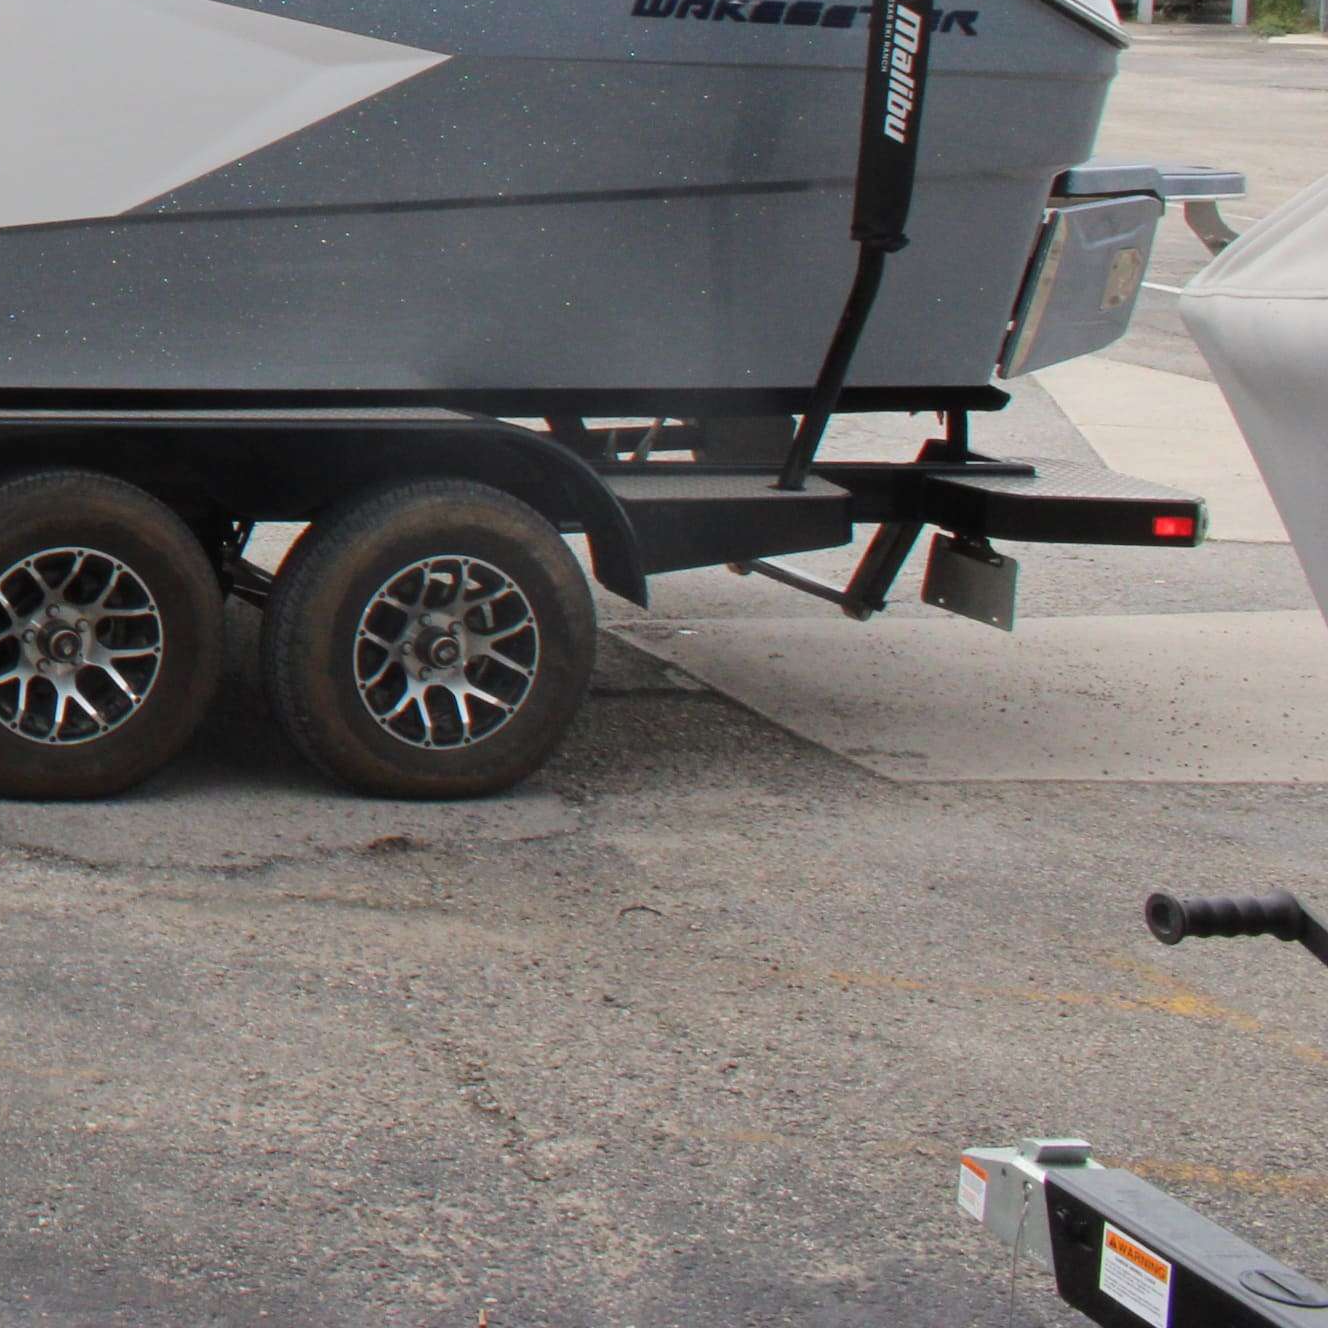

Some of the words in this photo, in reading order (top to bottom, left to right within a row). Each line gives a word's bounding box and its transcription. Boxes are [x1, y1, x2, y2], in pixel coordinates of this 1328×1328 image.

[884, 23, 893, 39] SKI
[881, 41, 891, 72] RANCH
[884, 3, 922, 144] Malibu
